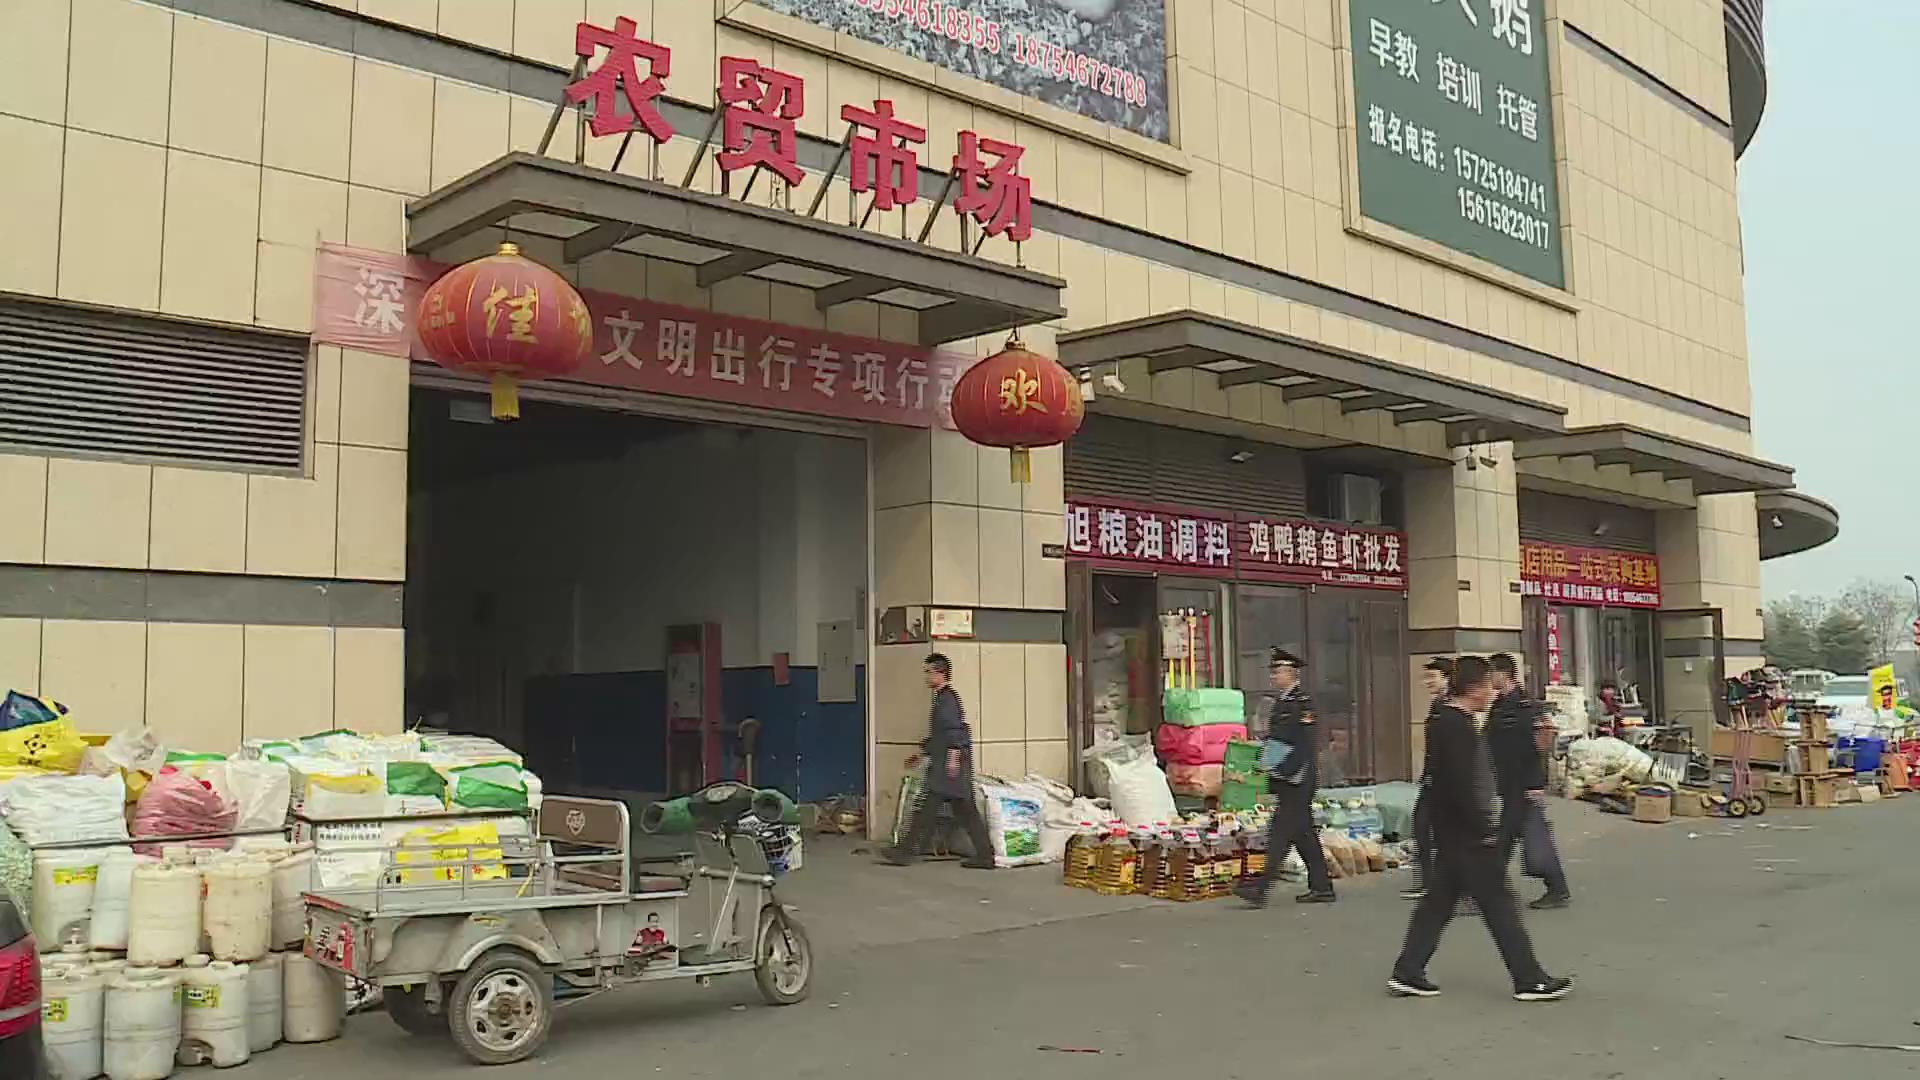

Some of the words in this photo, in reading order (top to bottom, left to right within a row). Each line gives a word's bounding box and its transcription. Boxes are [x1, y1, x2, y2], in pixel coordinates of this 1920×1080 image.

[1012, 32, 1148, 108] 18754672788
[1369, 17, 1420, 83] 早教
[1436, 52, 1482, 115] 培训
[1496, 84, 1538, 142] 托管
[564, 16, 1033, 243] 农贸市场
[1453, 146, 1546, 213] 15725184741
[1457, 187, 1549, 250] 15615823017
[1249, 520, 1401, 573] 鸡鸭鹅鱼虾批发
